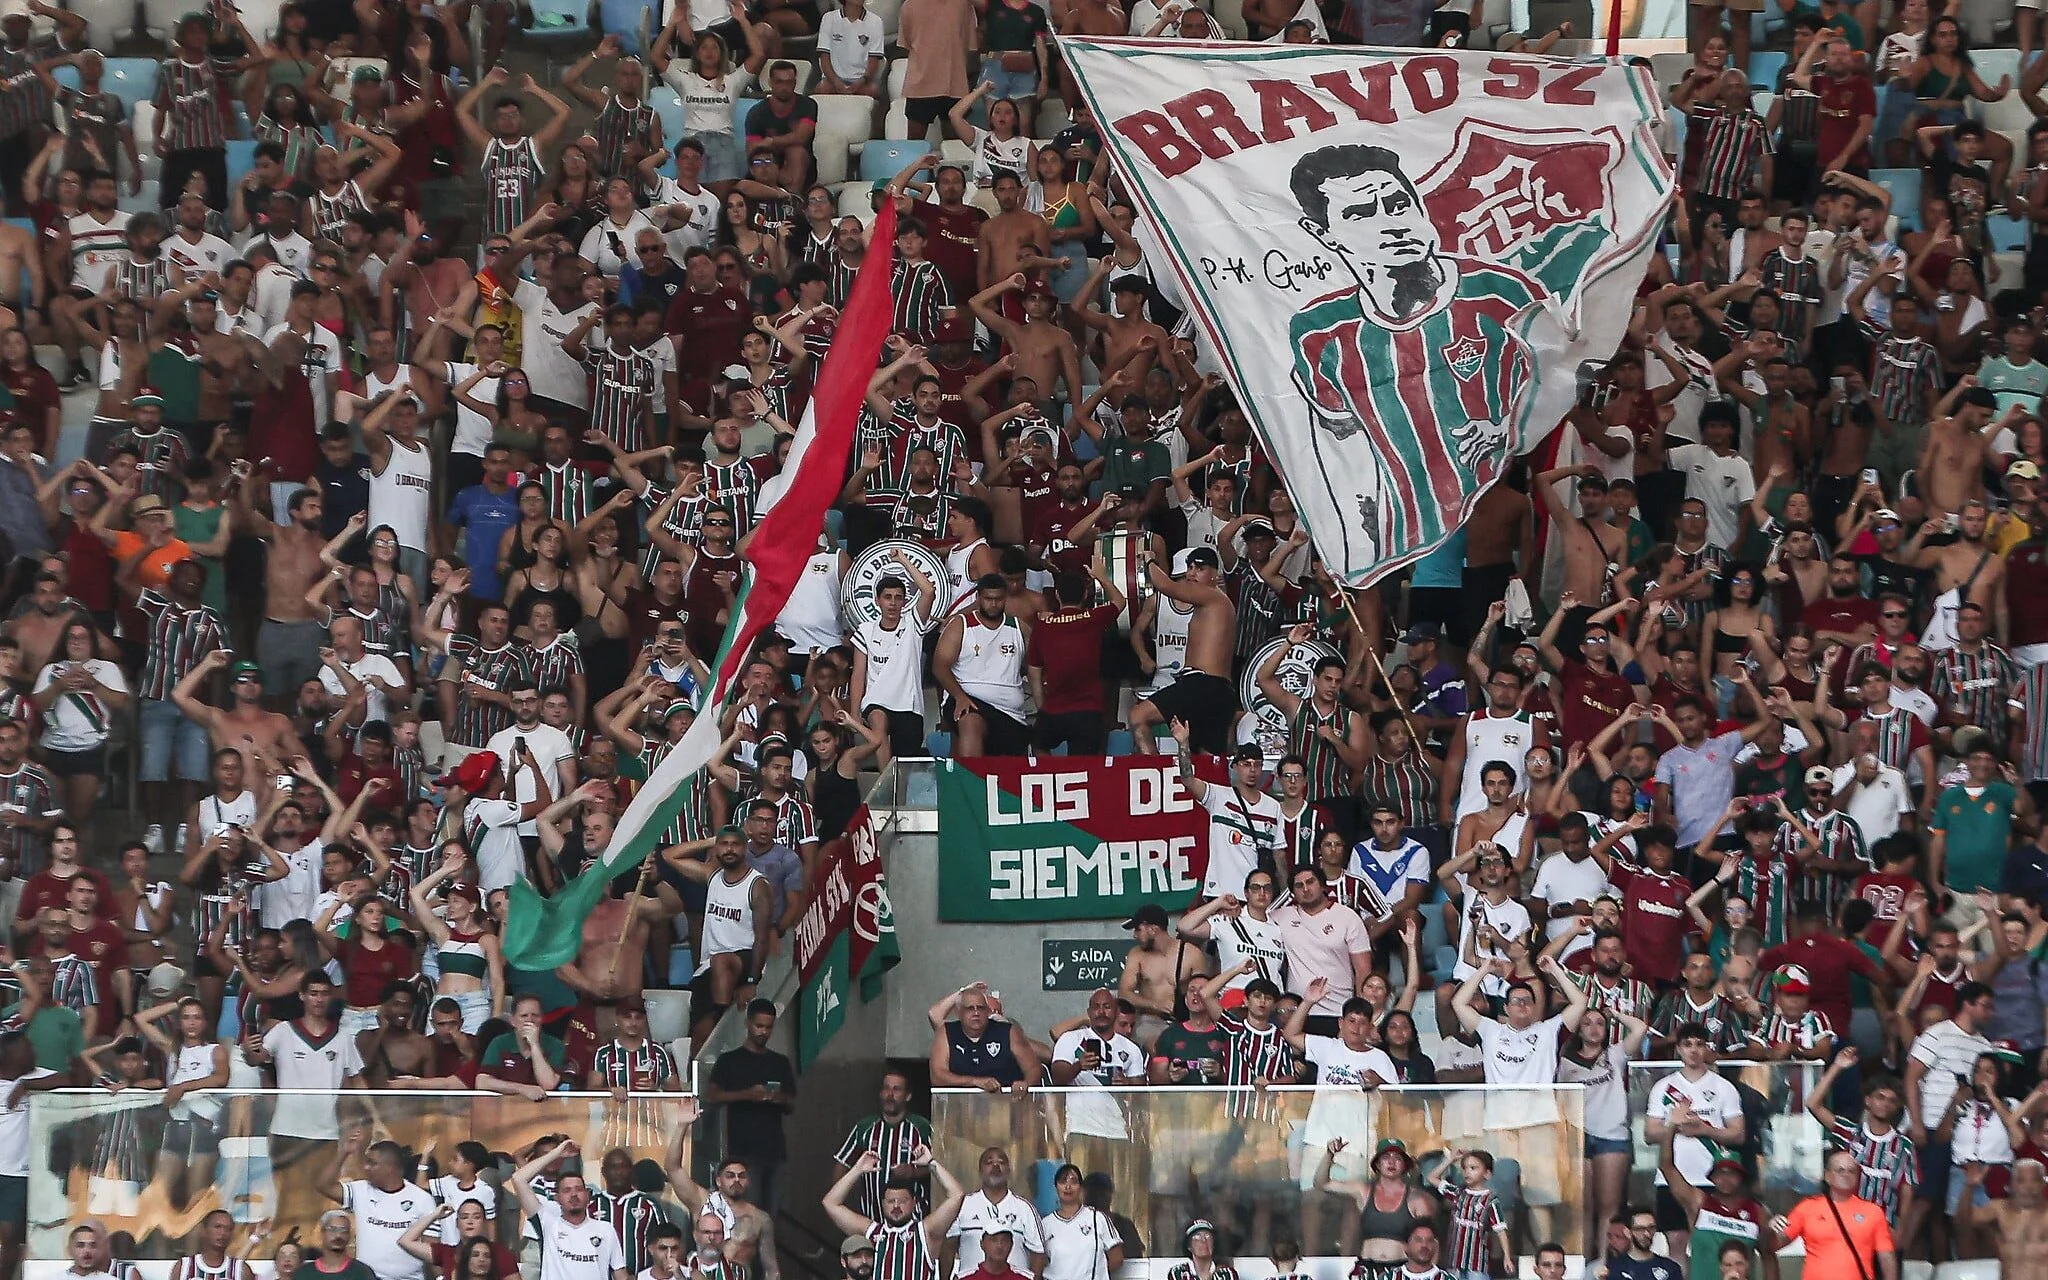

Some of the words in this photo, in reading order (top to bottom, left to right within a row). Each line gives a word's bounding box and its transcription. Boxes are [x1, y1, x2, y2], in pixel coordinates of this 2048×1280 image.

[1112, 56, 1460, 179] BRAVO
[1483, 57, 1606, 106] 52
[497, 179, 519, 199] 23
[715, 485, 751, 498] BETANO
[812, 564, 829, 574] 52
[1000, 644, 1015, 655] 52
[1264, 708, 1283, 722] DE
[1503, 734, 1519, 745] 52
[986, 771, 1090, 826] LOS
[1129, 766, 1196, 816] DE
[989, 836, 1200, 900] SIEMPRE
[1071, 947, 1114, 962] SAÍDA
[1236, 943, 1283, 961] Unimed
[1077, 967, 1109, 980] EXIT
